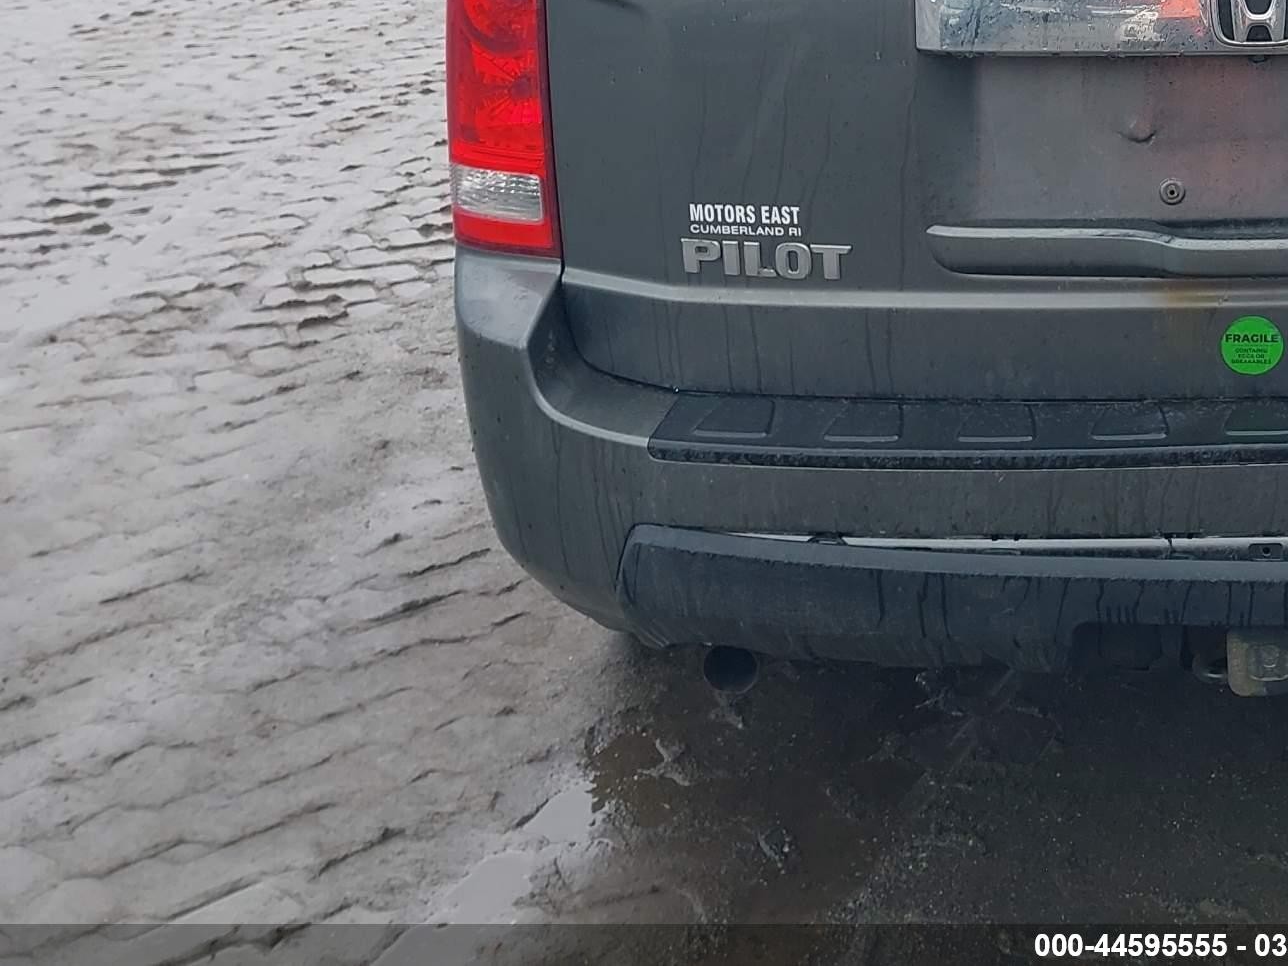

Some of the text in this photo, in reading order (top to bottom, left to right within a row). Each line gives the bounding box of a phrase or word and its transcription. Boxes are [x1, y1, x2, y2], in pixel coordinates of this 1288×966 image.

[689, 203, 800, 225] MOTORS EAST
[690, 224, 802, 237] CUMBERLAND RI
[680, 238, 852, 280] PILOT
[1225, 334, 1279, 343] FRAGILE
